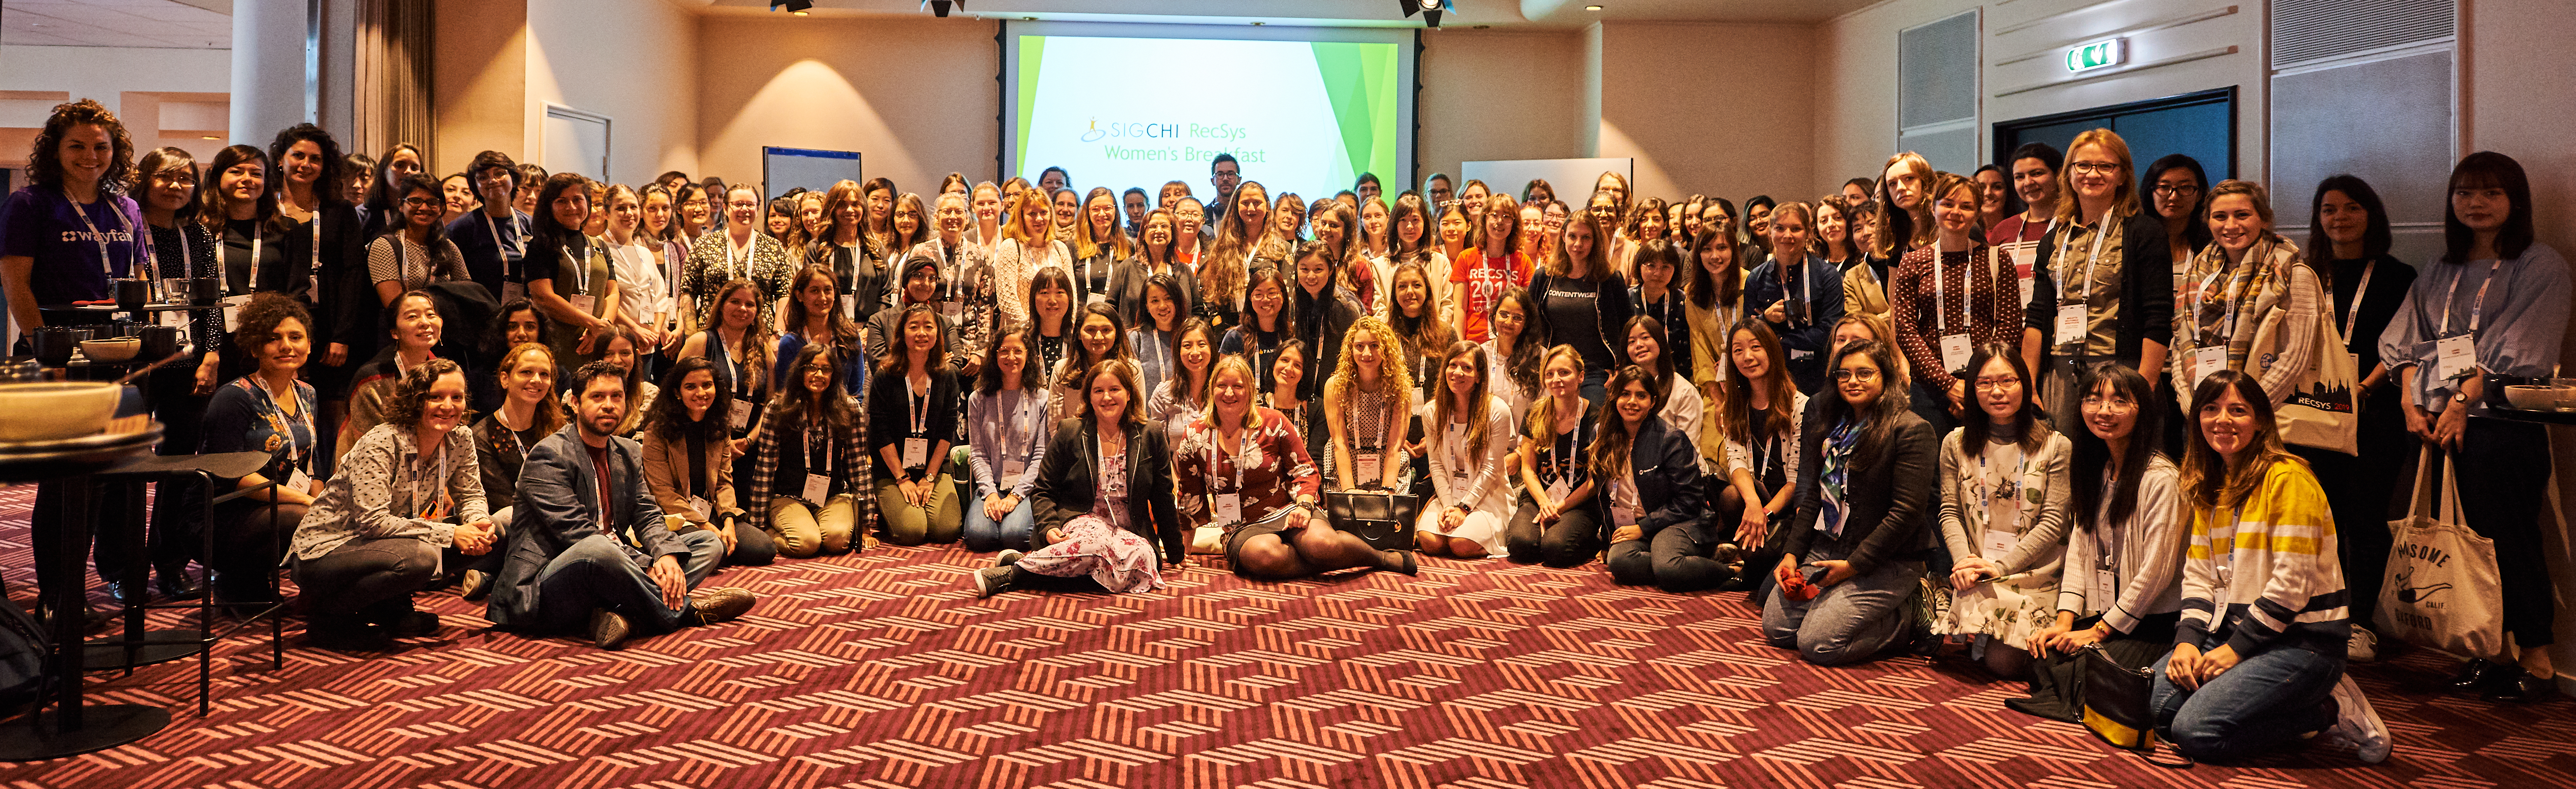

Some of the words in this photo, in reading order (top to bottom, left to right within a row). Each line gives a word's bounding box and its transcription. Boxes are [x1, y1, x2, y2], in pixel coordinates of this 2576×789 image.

[1111, 122, 1179, 138] SIGCHI
[1190, 123, 1246, 142] RecSys
[1104, 145, 1178, 162] Women's
[2298, 397, 2331, 409] RECSYS
[2334, 402, 2350, 411] 2019
